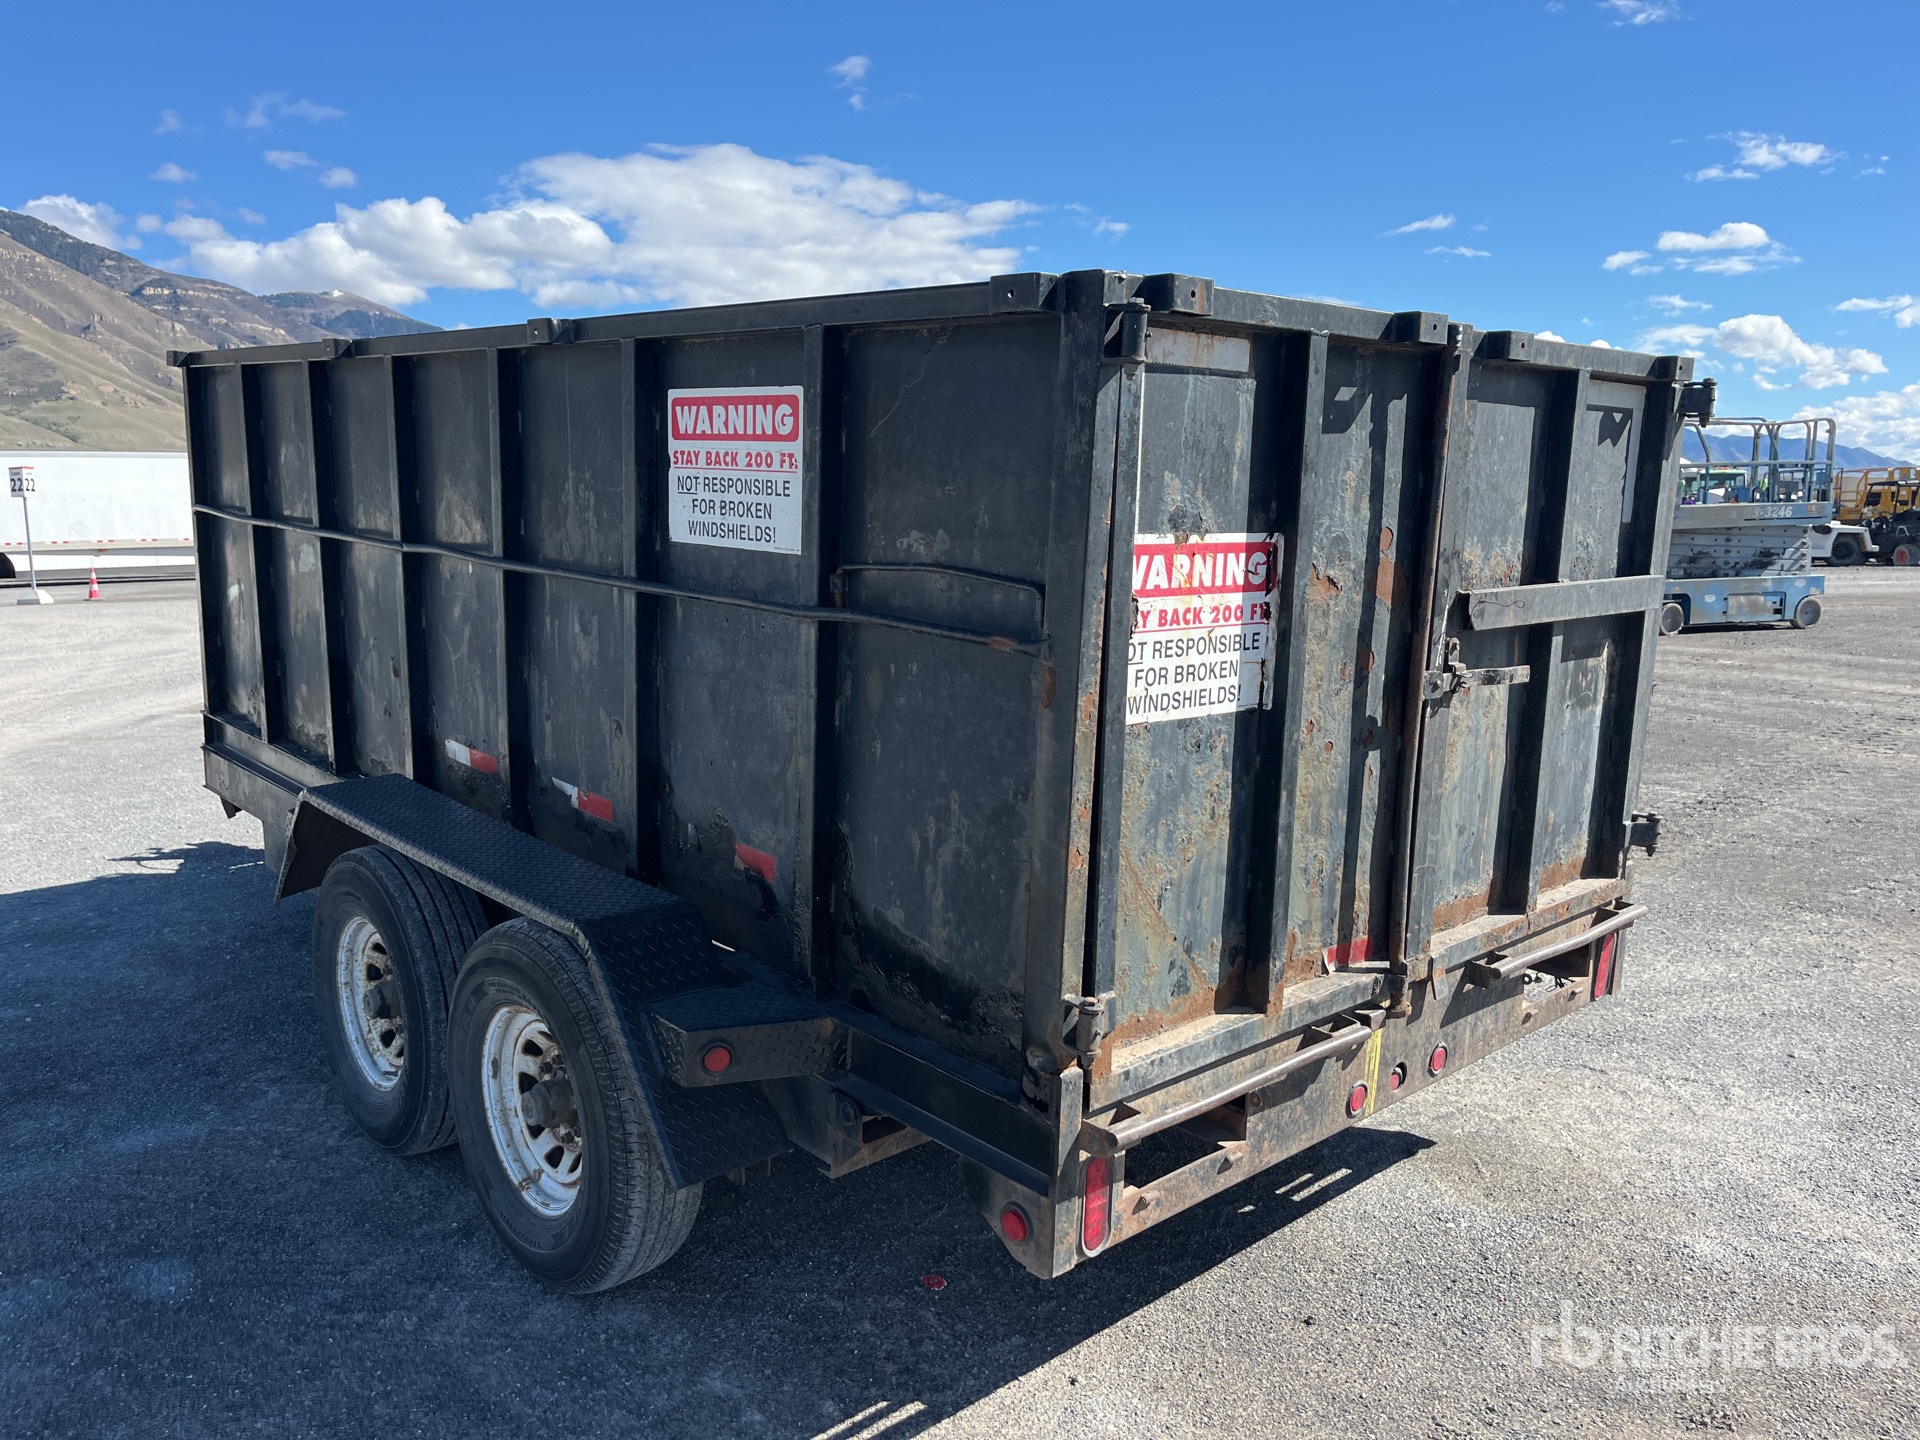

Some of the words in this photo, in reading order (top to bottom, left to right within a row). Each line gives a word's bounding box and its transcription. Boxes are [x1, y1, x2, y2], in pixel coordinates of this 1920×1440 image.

[675, 404, 794, 435] WARNING
[673, 450, 700, 466] STAY
[706, 451, 739, 468] BACK
[745, 452, 774, 469] 200
[780, 452, 798, 470] FT.
[10, 478, 23, 492] 22
[25, 478, 35, 492] 22
[677, 475, 700, 493] NOT
[703, 477, 791, 497] RESPONSIBLE
[692, 499, 716, 515] FOR
[720, 501, 772, 519] BROKEN
[688, 520, 776, 543] WINDSHIELDS!
[1158, 607, 1203, 627] BACK
[1128, 641, 1148, 662] OT
[1152, 632, 1260, 660] RESPONSIBLE
[1134, 668, 1169, 688] FOR
[1174, 659, 1239, 684] BROKEN
[1127, 684, 1242, 716] WINDSHIELDS!
